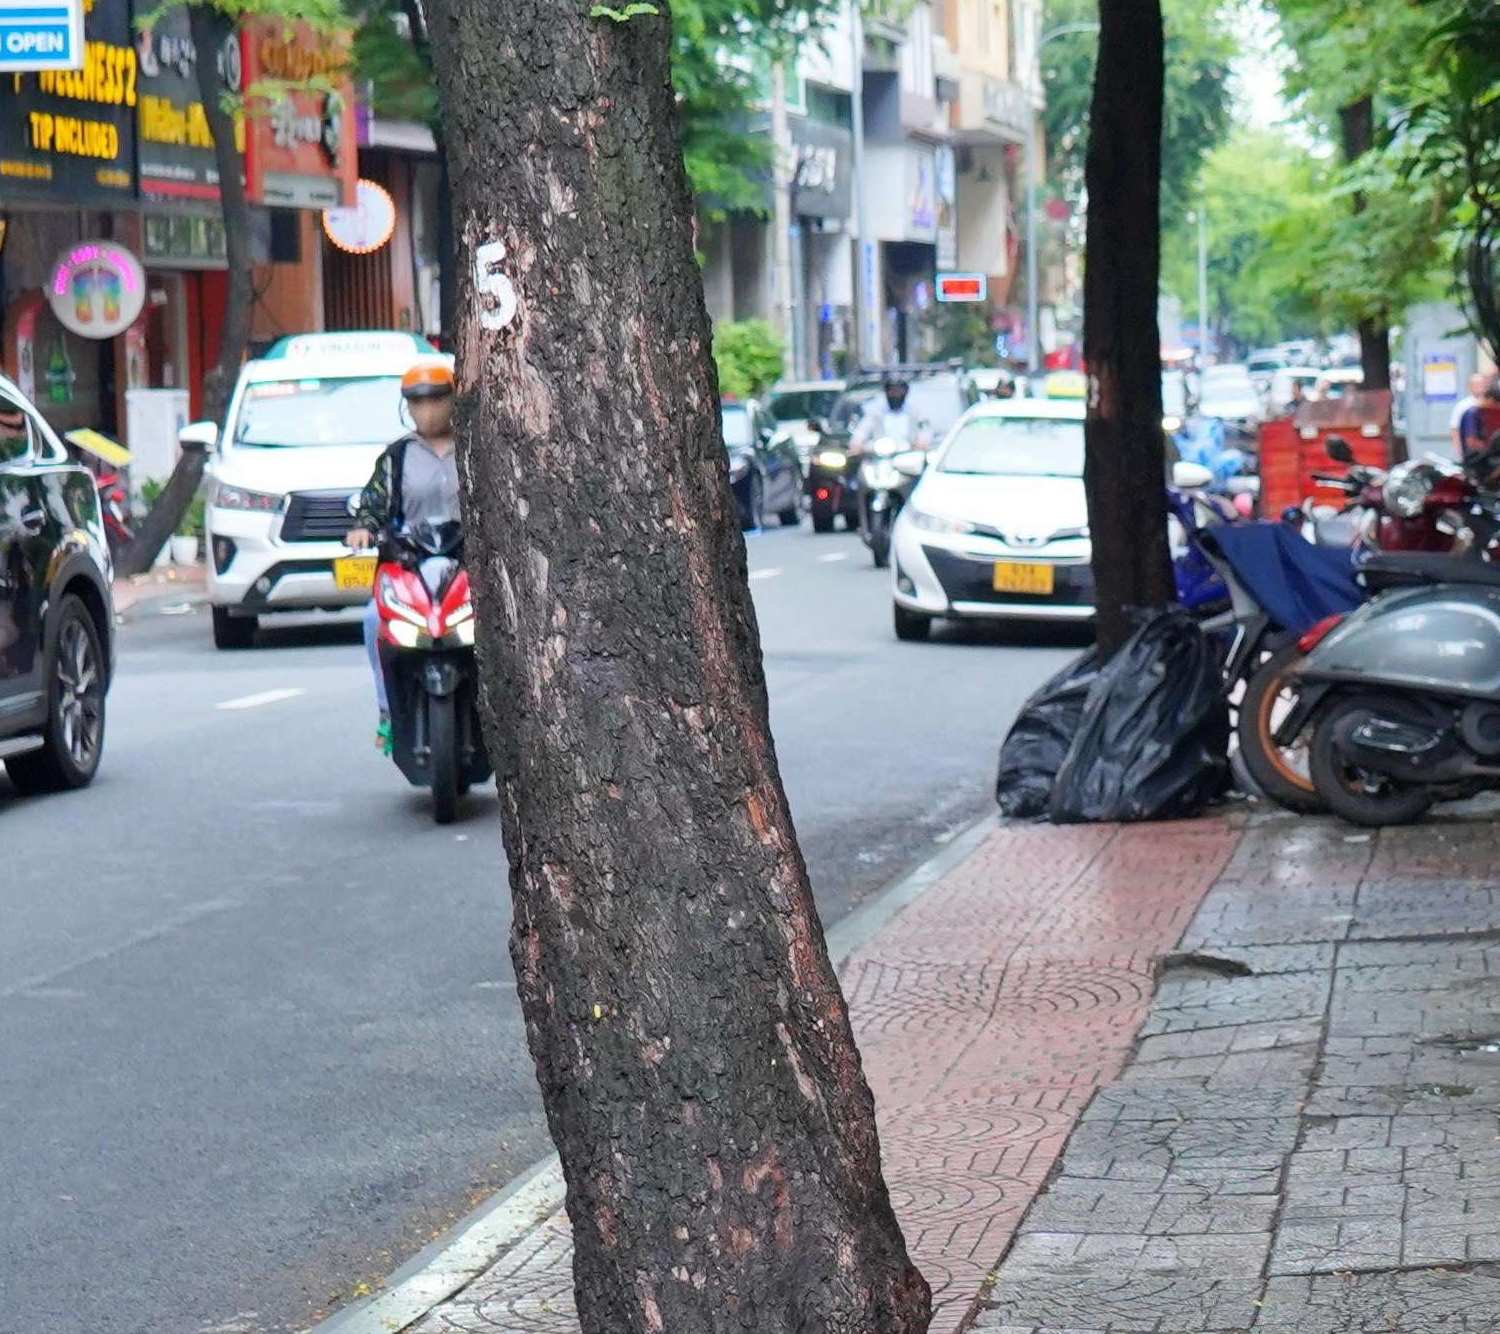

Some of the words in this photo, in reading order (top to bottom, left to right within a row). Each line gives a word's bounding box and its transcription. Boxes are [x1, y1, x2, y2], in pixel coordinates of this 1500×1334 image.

[6, 31, 64, 53] OPEN
[30, 111, 53, 150] TIP
[55, 115, 119, 159] INCLUDED
[473, 240, 519, 331] 5
